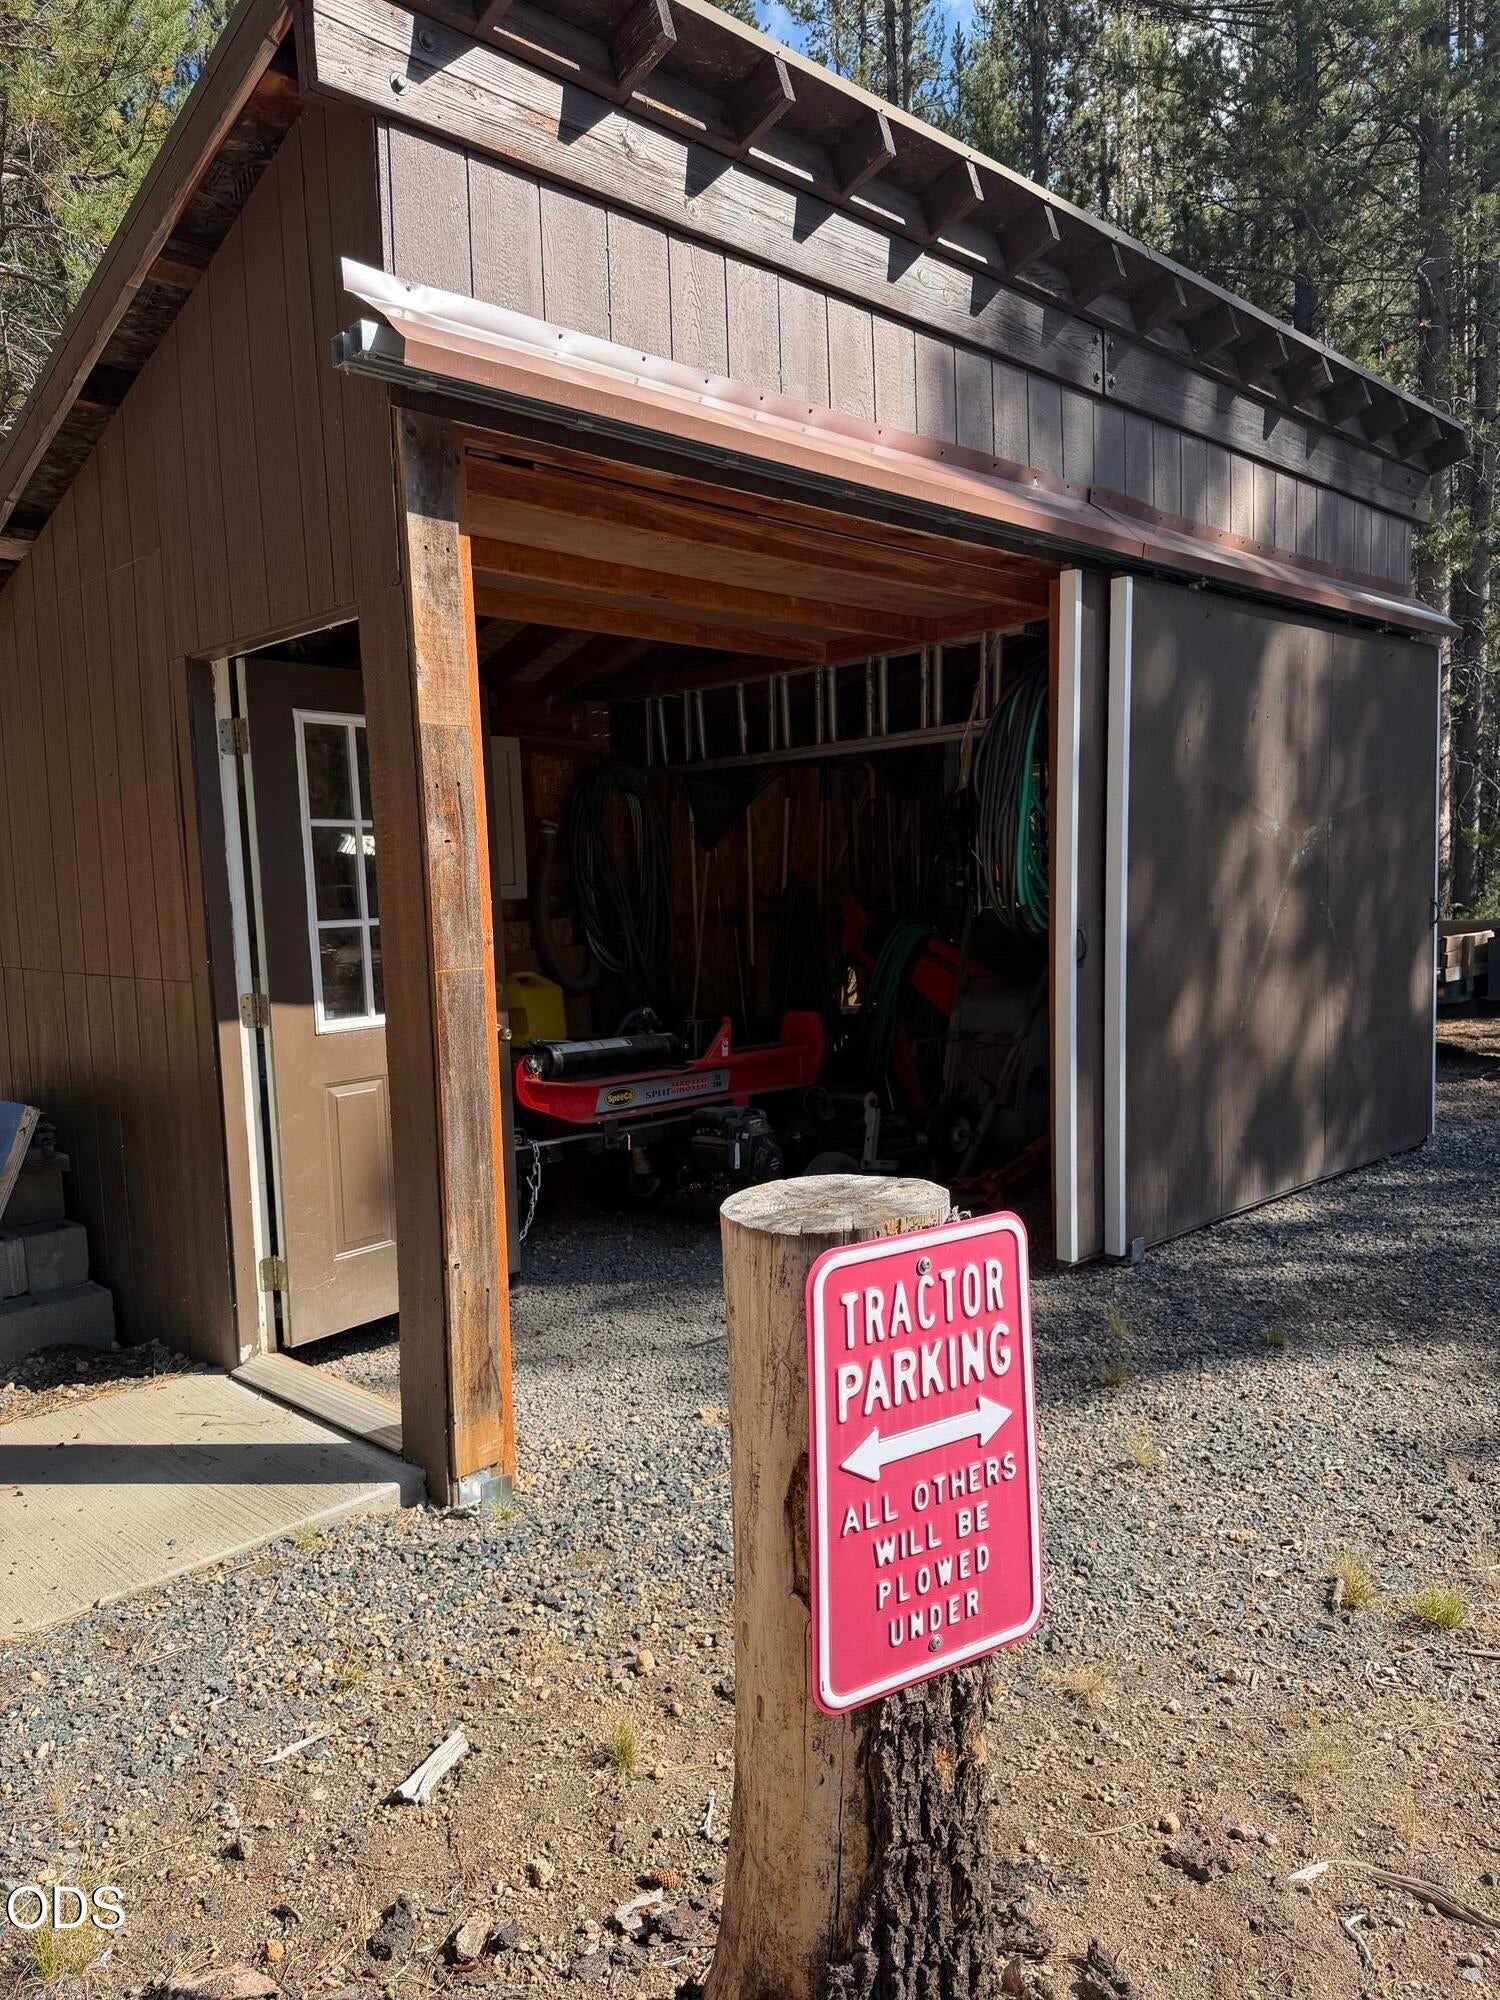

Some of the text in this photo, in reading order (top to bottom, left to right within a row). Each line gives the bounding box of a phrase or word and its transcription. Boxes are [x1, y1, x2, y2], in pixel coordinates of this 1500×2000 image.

[840, 1259, 1004, 1350] TRACTOR
[837, 1321, 1012, 1424] PARKING
[841, 1451, 1017, 1537] ALL OTHERS
[873, 1500, 990, 1568] WILL BE
[877, 1543, 990, 1611] PLOWED
[889, 1587, 979, 1648] UNDER
